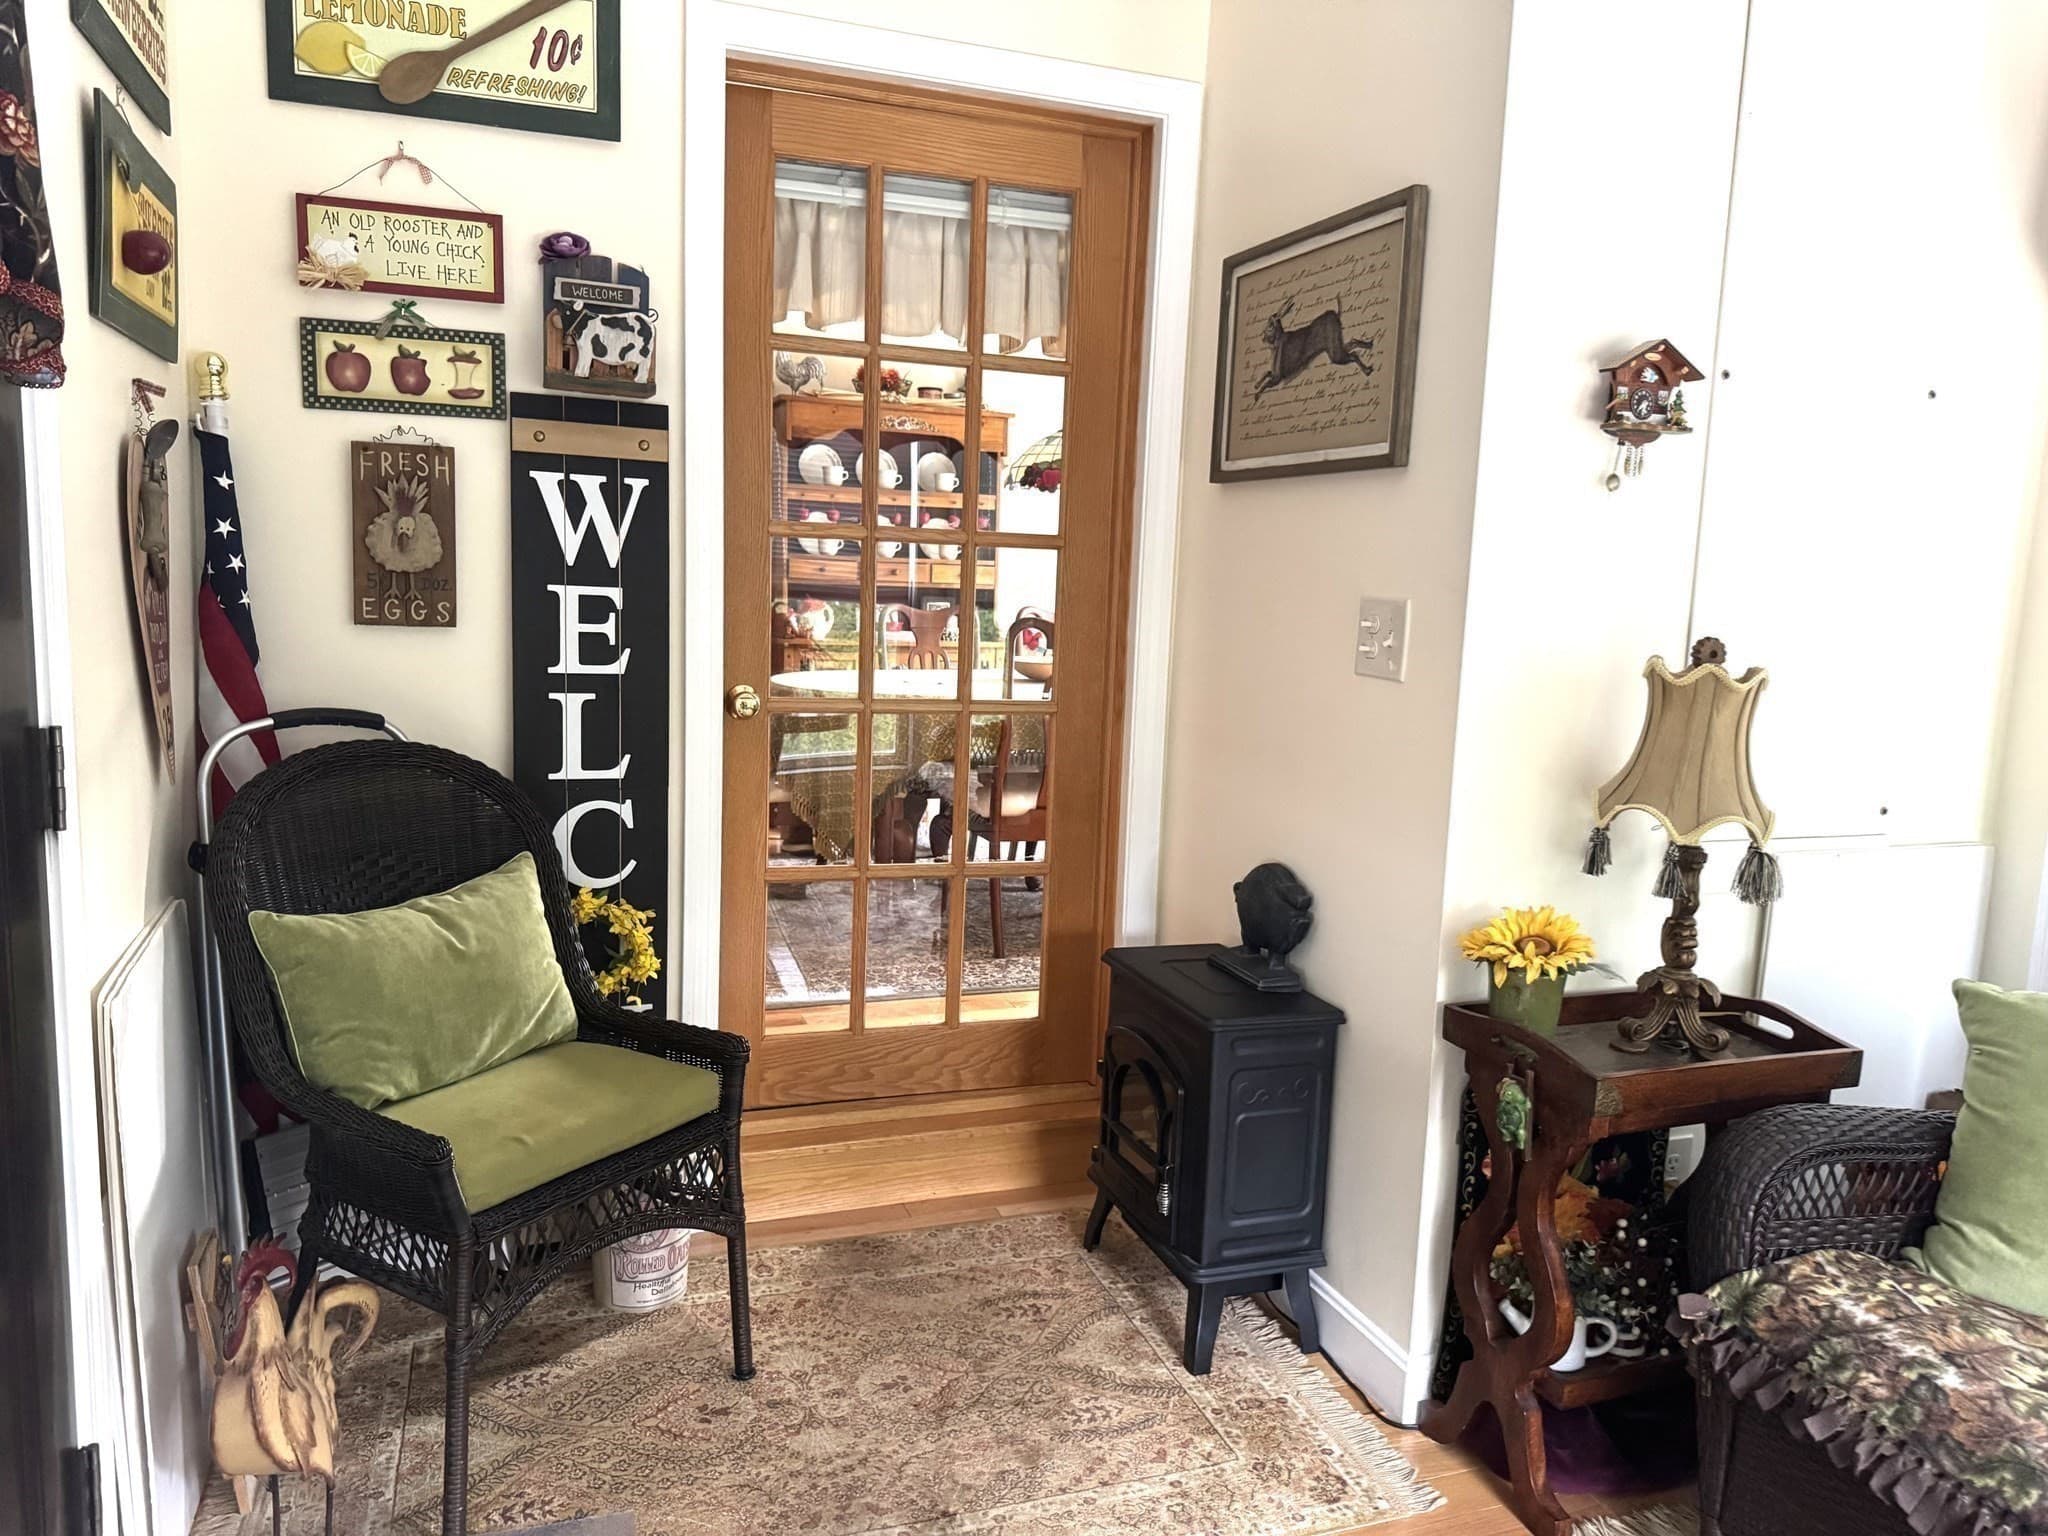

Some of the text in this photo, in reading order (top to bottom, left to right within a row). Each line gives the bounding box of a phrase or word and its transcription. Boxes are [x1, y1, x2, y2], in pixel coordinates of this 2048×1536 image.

[303, 0, 467, 40] LEMONADE
[447, 67, 588, 104] REFRESHING!
[321, 209, 484, 239] AN OLD ROOSTER AND
[364, 234, 375, 253] A
[384, 235, 430, 255] YOUNG
[386, 259, 482, 286] LIVE HERE
[572, 285, 624, 301] WELCOME
[360, 450, 450, 487] FRESH
[362, 597, 451, 623] EGGS
